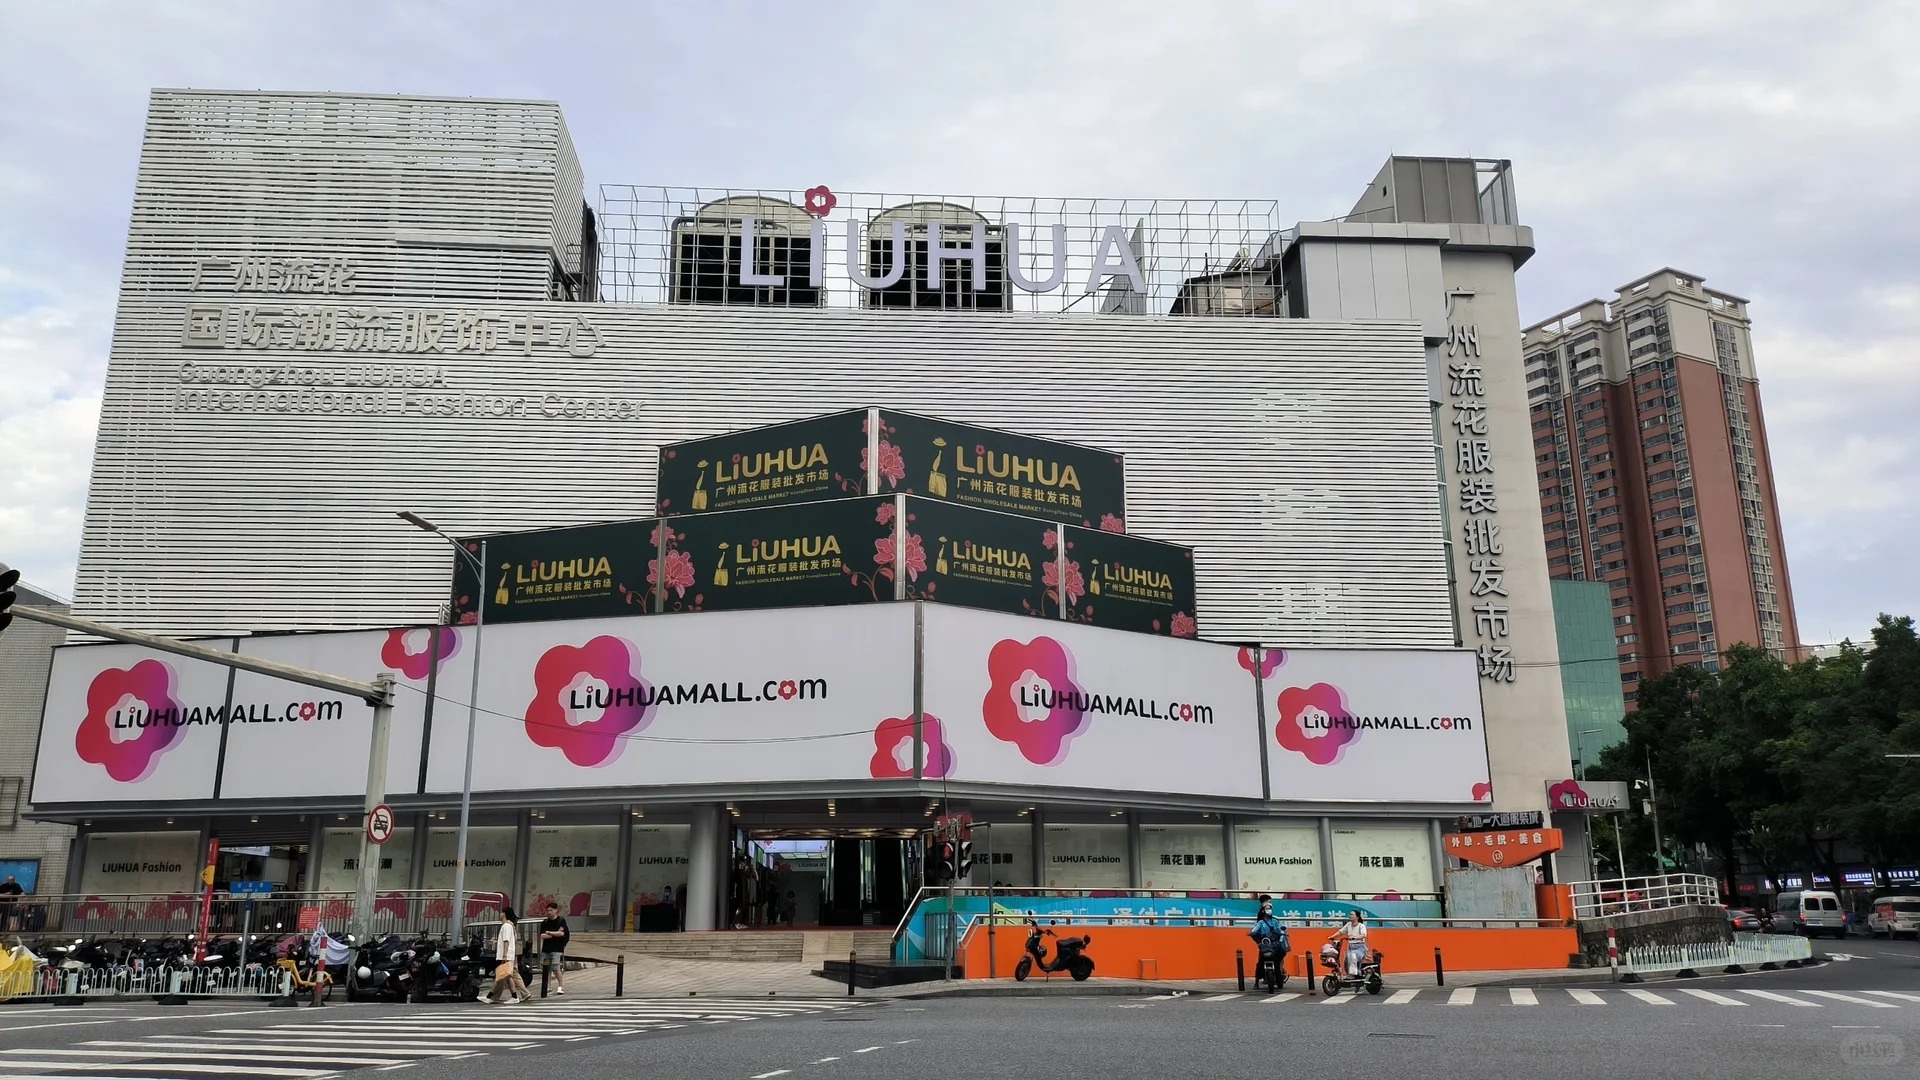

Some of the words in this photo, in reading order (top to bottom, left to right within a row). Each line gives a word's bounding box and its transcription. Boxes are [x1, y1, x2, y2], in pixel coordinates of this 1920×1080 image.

[189, 256, 357, 295] 广州流花
[181, 303, 606, 357] 国际潮流服饰中心
[177, 361, 335, 388] Guangzhou
[345, 364, 447, 388] LIUHUA
[172, 384, 389, 413] International
[400, 389, 527, 416] Fashion
[540, 393, 646, 419] Center
[714, 469, 829, 498] 广州流花服装批发市场
[1446, 285, 1517, 683] 广州流花服装批发市场
[736, 495, 767, 504] WHOLESALE
[768, 491, 789, 500] MARKET
[957, 476, 1082, 509] 广州流花服装批发市场
[957, 494, 982, 504] FASHION
[983, 498, 1018, 510] WHOLESALE
[1018, 503, 1042, 513] MARKET
[735, 558, 842, 577] 广州流花服装批发市场
[515, 577, 612, 596] 广州流花服装批发市场
[102, 862, 140, 873] LIUHUA
[142, 861, 182, 873] Fashion
[343, 858, 393, 870] 流潮
[471, 858, 507, 868] Fashion
[549, 856, 597, 868] 流花国潮
[638, 857, 673, 865] LIUHUA
[1052, 855, 1086, 863] LIUHUA
[1087, 855, 1121, 863] Fashion
[1160, 854, 1206, 866] 流花国潮
[1244, 856, 1278, 865] LIUHUA
[1279, 856, 1313, 865] Fashion
[1359, 856, 1405, 868] 流花国潮
